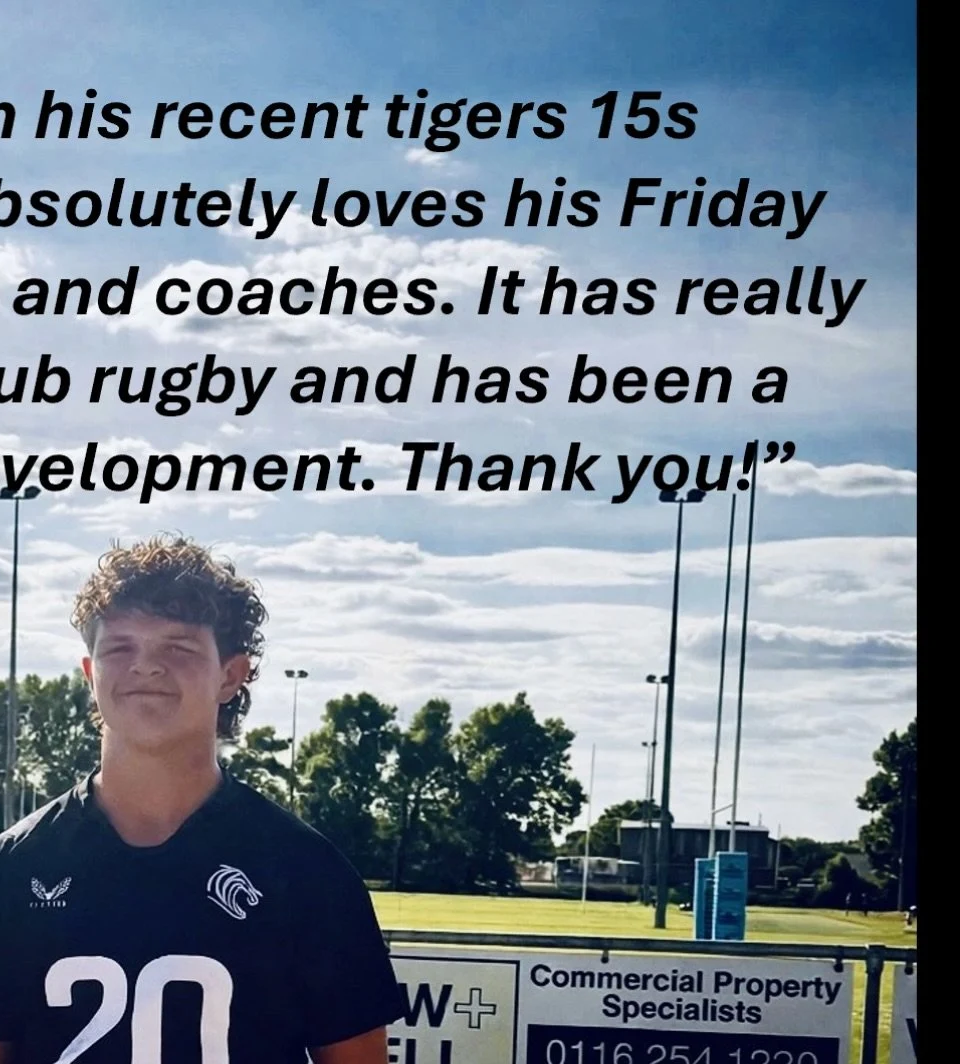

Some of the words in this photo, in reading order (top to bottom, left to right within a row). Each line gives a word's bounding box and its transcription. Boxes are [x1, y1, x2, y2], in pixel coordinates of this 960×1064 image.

[530, 964, 704, 994] Commercial
[714, 971, 843, 1005] Property
[602, 994, 762, 1024] Specialists
